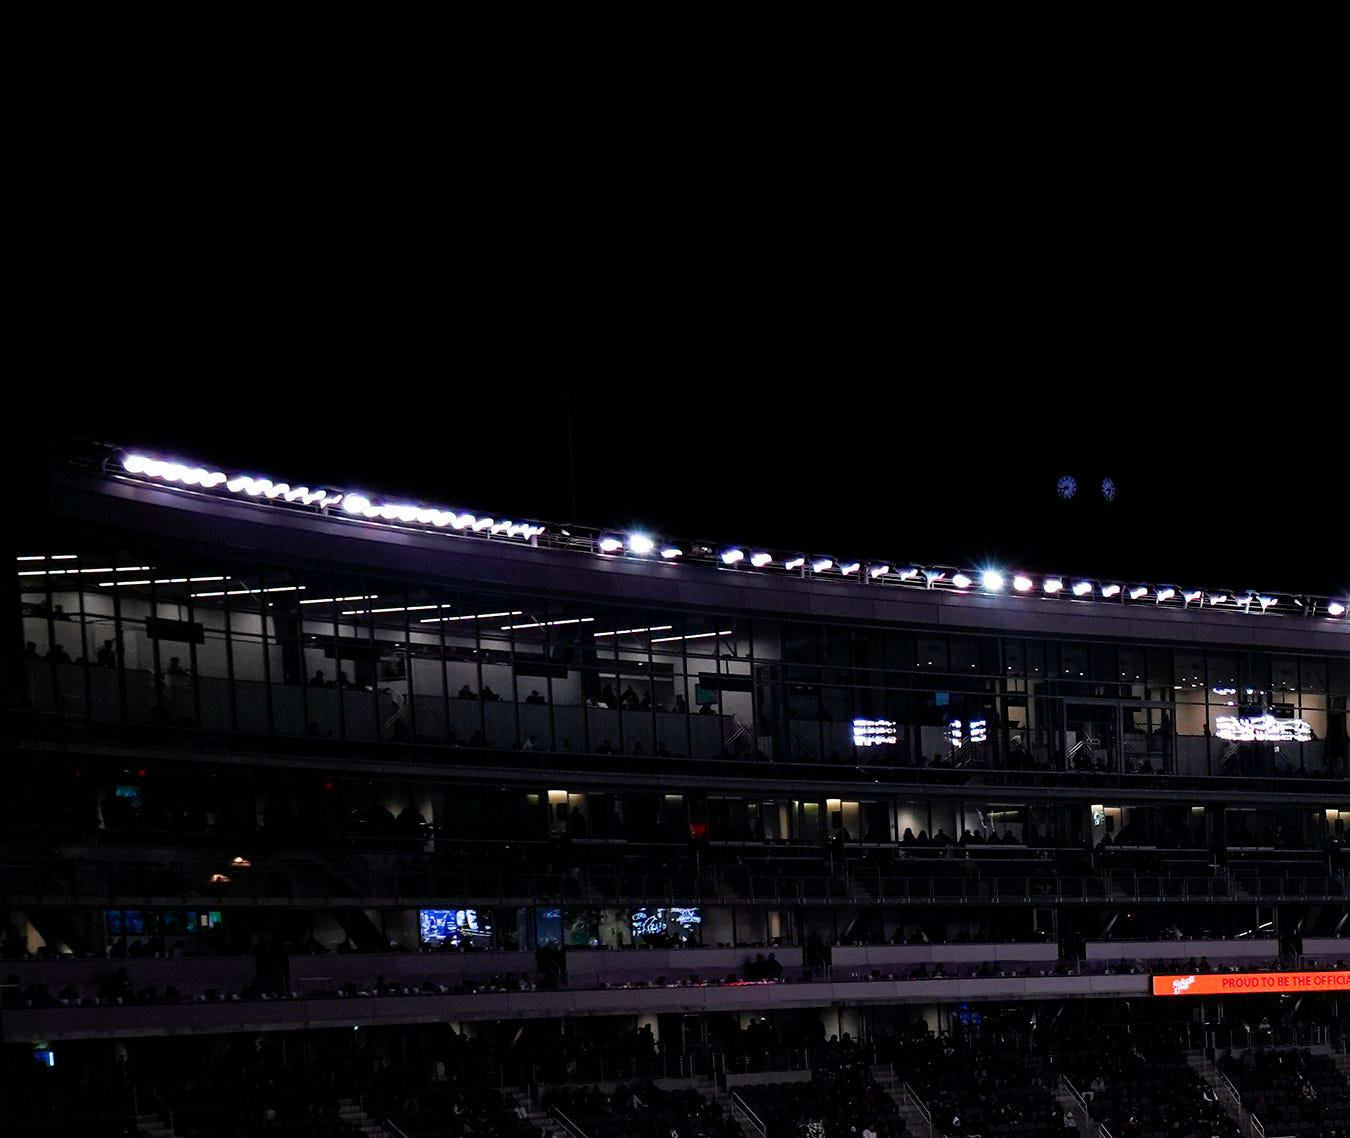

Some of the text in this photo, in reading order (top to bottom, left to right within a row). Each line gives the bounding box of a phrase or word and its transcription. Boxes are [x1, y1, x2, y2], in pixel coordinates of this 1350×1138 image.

[1223, 977, 1259, 989] PROUD
[1262, 977, 1275, 988] TO
[1278, 976, 1290, 987] BE
[1291, 975, 1312, 986] THE
